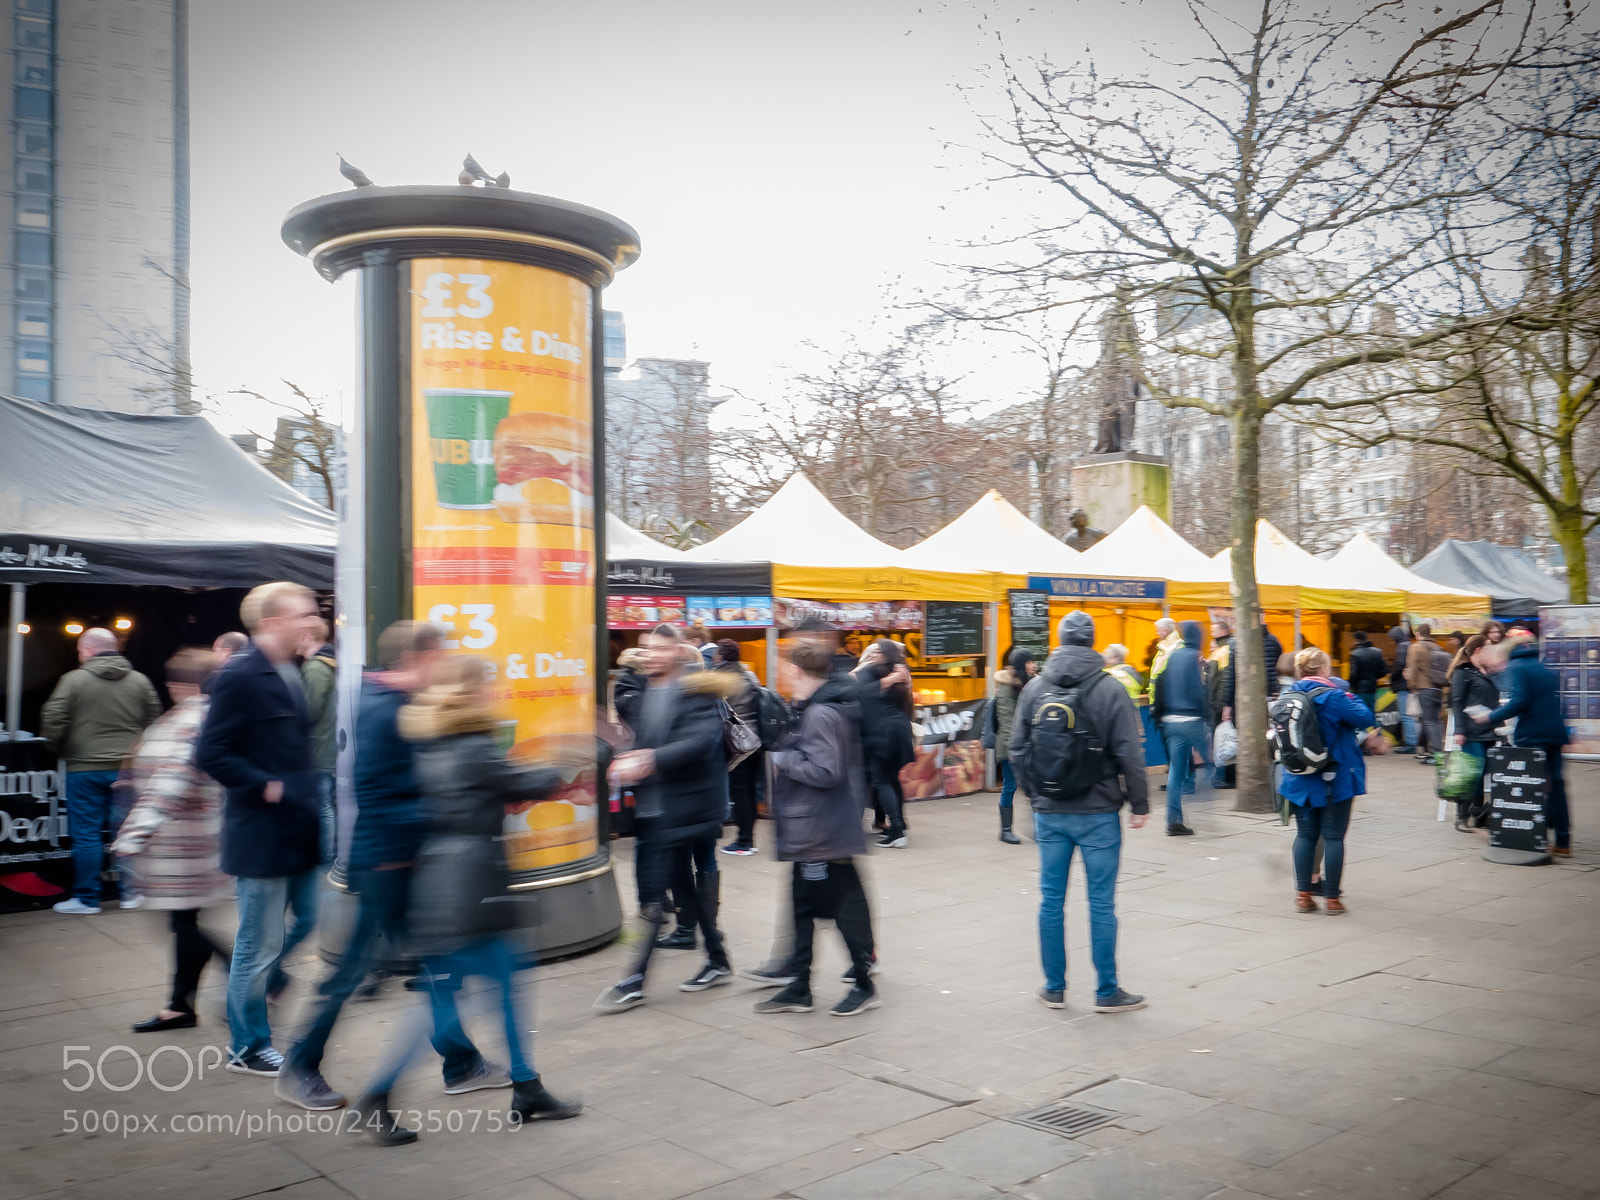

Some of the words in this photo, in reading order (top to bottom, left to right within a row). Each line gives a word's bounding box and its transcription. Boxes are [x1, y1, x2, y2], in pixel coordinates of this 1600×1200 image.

[421, 272, 494, 319] £3
[421, 322, 494, 350] Rise
[500, 326, 526, 353] &
[531, 330, 582, 364] Dine
[428, 604, 498, 649] £3
[506, 653, 529, 679] &
[535, 652, 586, 678] Dine
